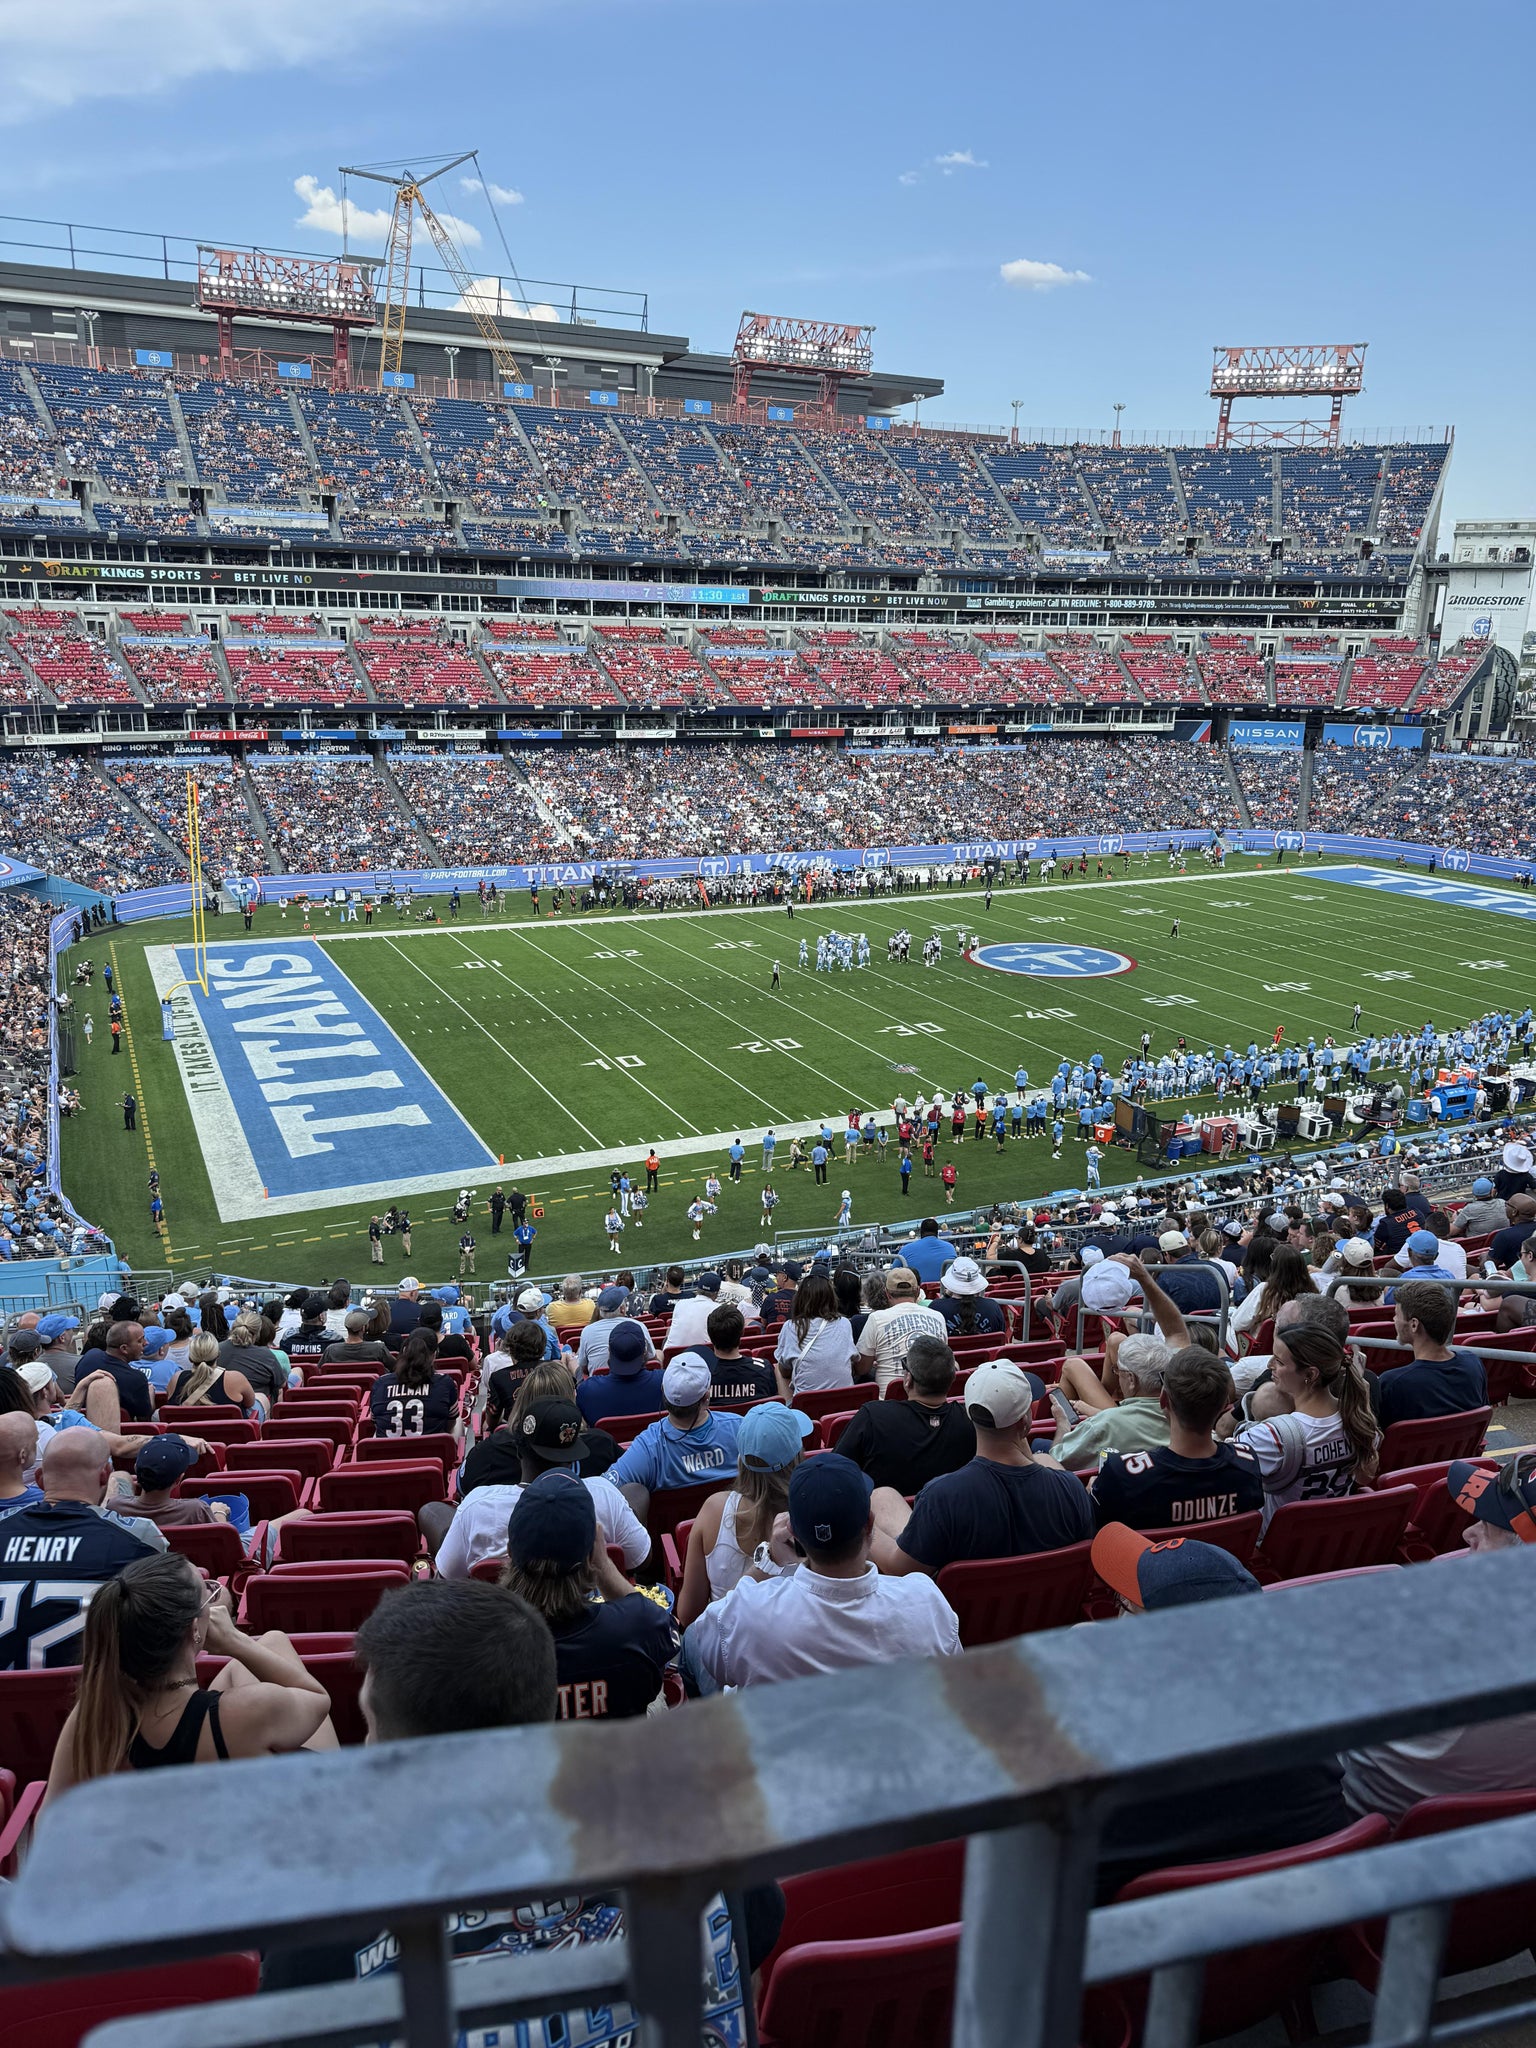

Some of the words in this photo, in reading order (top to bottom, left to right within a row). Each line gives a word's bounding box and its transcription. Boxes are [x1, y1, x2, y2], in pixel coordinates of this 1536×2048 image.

[46, 564, 144, 578] DRAFTKINGS
[150, 569, 201, 580] SPORTS
[234, 572, 256, 583] BET
[262, 574, 289, 584] LIVE
[294, 575, 312, 584] NO
[451, 580, 494, 591] SPORTS
[643, 587, 650, 598] 7
[690, 590, 723, 600] 11:30
[731, 592, 746, 601] 1st
[762, 591, 829, 603] DRAFTKINGS
[832, 594, 867, 604] SPORTS
[887, 596, 903, 605] BET
[906, 597, 925, 605] LIVE
[927, 597, 949, 606] NOW
[984, 597, 1015, 607] Gambling
[1015, 598, 1046, 608] problem?
[1047, 599, 1060, 607] Call
[1060, 599, 1070, 607] TN
[1071, 599, 1102, 608] REDLINE:
[1448, 595, 1526, 606] BRIDGESTONE
[1233, 727, 1299, 738] NISSAN
[13, 751, 57, 759] TITANS
[953, 843, 1008, 859] TITAN
[1013, 842, 1037, 855] UP
[522, 864, 597, 882] TITAN
[2, 875, 31, 887] NISSAN
[170, 996, 190, 1006] US
[1140, 994, 1200, 1006] 50
[172, 1009, 194, 1019] OF
[1026, 1008, 1078, 1020] 40
[171, 1022, 203, 1038] ALL
[884, 1022, 947, 1036] 30
[739, 1038, 804, 1054] 20
[180, 1042, 215, 1078] TAKES
[206, 953, 432, 1159] TITANS
[595, 1055, 647, 1071] 10
[190, 1082, 221, 1093] IT
[1097, 1129, 1105, 1138] G
[1394, 1210, 1418, 1223] CUTLER
[291, 1344, 321, 1353] HOPKINS
[387, 1384, 430, 1398] TILLMAN
[386, 1399, 425, 1438] 33
[1314, 1440, 1352, 1465] COHEN
[682, 1448, 726, 1474] WARD
[1121, 1450, 1154, 1474] 15
[1171, 1493, 1237, 1523] ODUNZE
[4, 1537, 82, 1562] HENRY
[557, 1680, 609, 1720] TER
